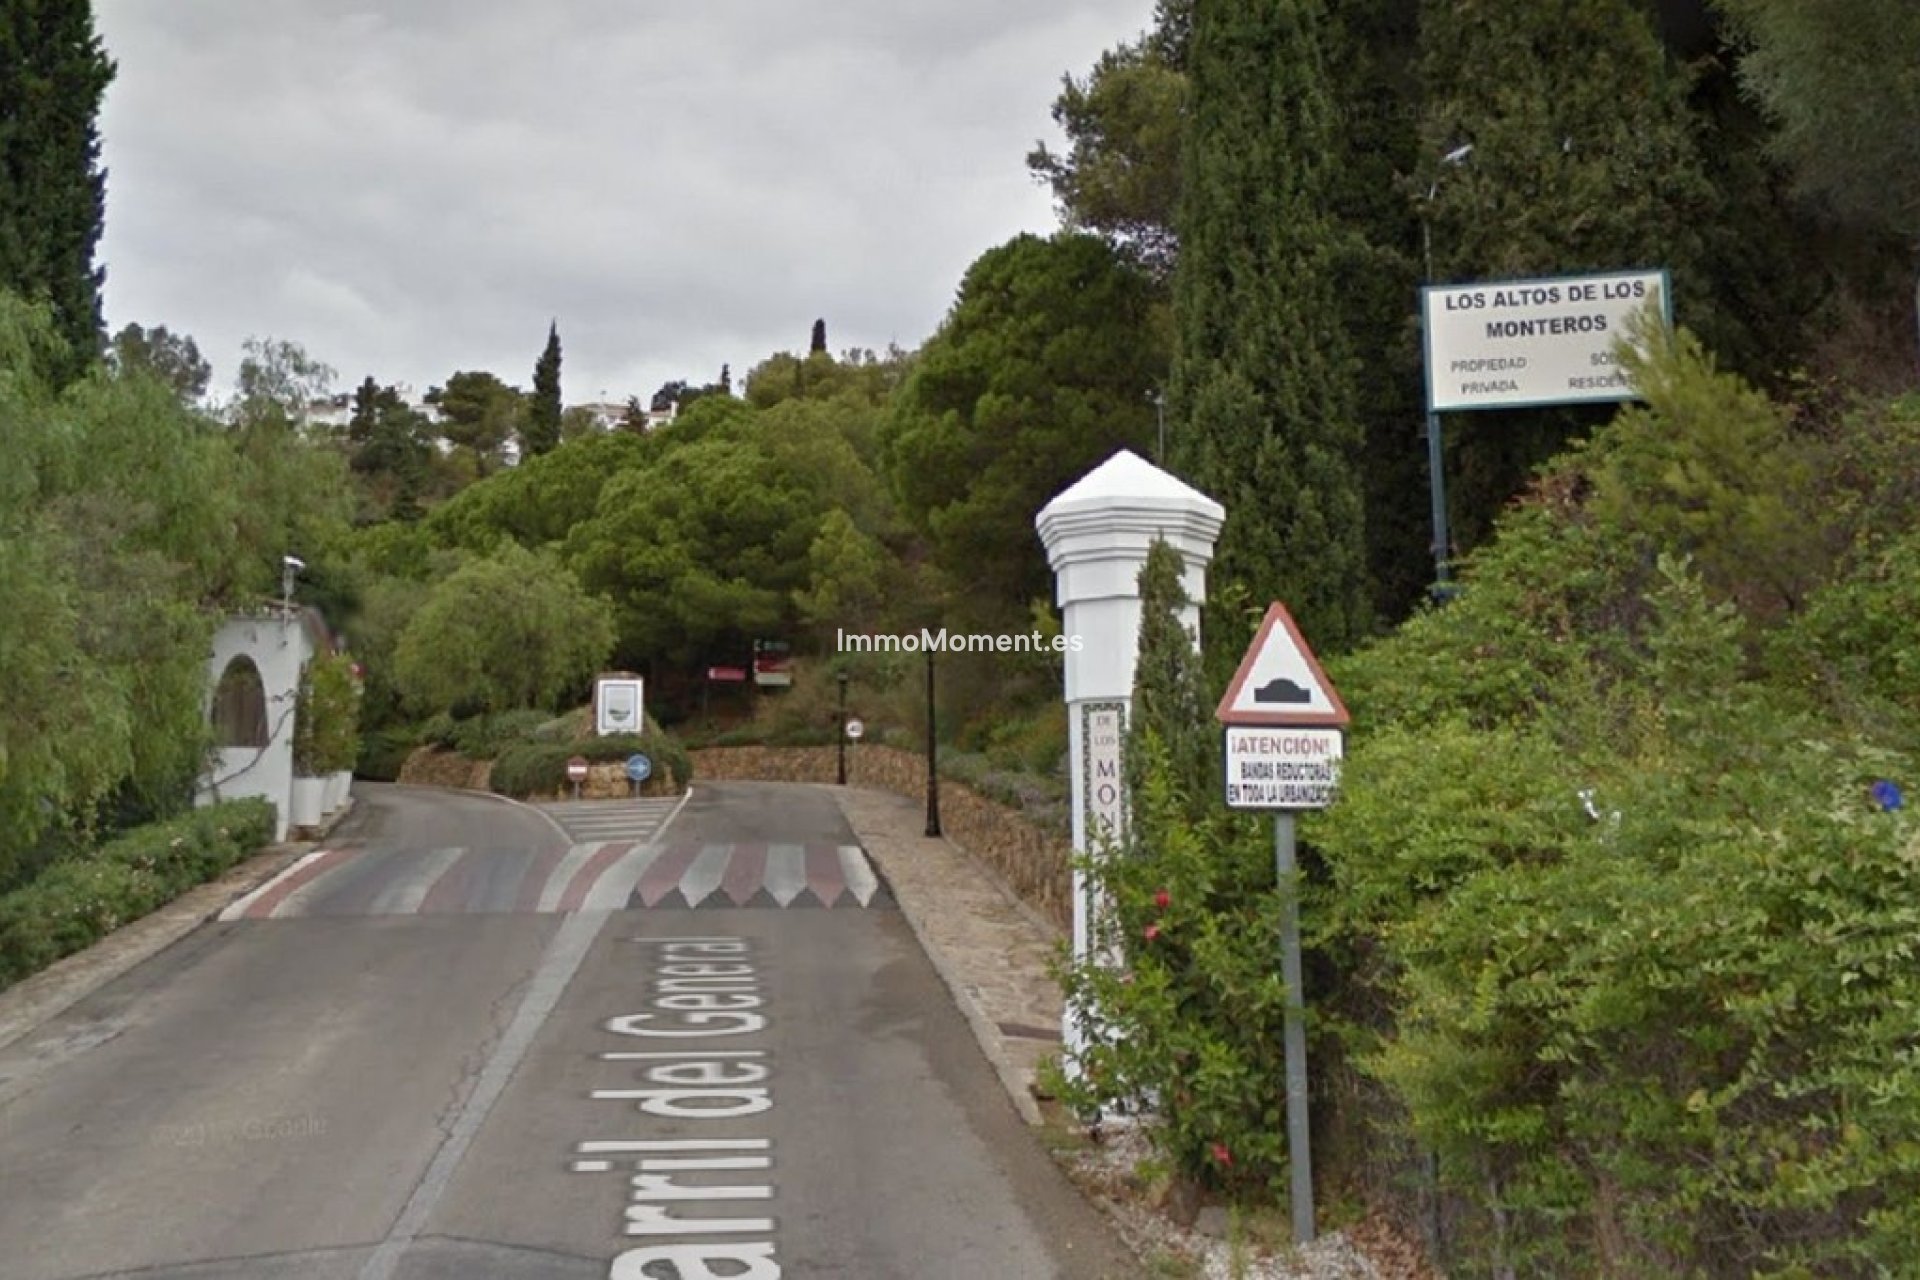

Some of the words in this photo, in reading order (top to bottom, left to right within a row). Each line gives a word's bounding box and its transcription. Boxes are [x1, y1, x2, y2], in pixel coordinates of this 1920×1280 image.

[1445, 292, 1486, 311] LOS
[1492, 287, 1562, 308] ALTOS
[1568, 284, 1597, 302] DE
[1603, 280, 1646, 300] LOS
[1486, 314, 1608, 338] MONTEROS
[1451, 356, 1528, 373] PROPIEDAD
[1461, 379, 1519, 395] PRIVADA
[1241, 762, 1274, 780] BANDAS
[1229, 783, 1240, 802] EN
[1266, 783, 1277, 802] LA
